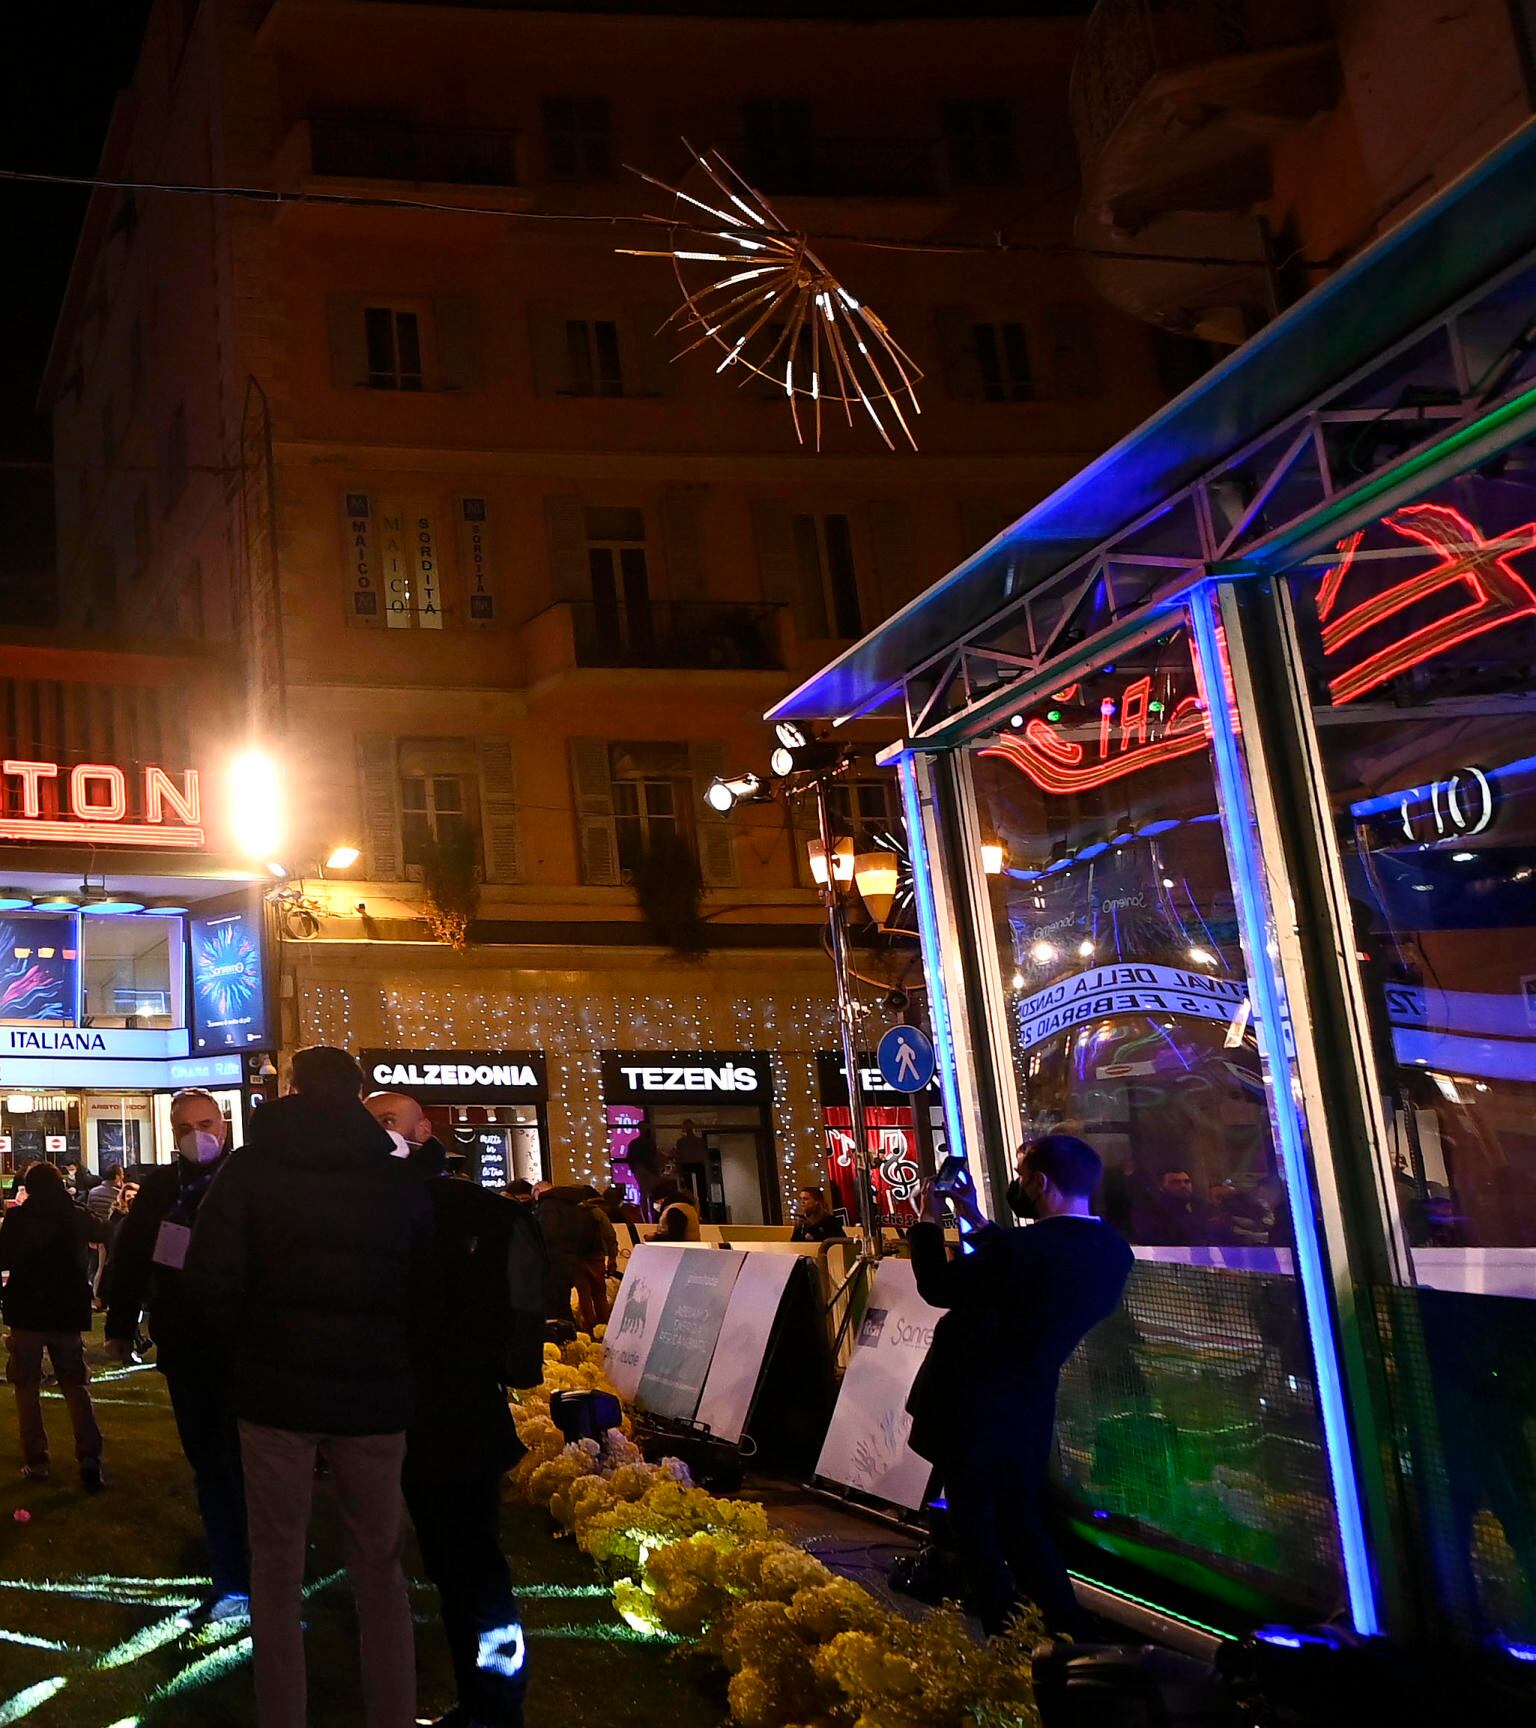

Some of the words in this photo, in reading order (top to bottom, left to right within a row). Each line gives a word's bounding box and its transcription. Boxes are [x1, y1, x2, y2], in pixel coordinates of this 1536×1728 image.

[11, 1032, 106, 1050] ITALIANA
[373, 1064, 538, 1086] CALZEDONIA
[621, 1062, 757, 1091] TEZENIS
[891, 1318, 933, 1346] Sanre
